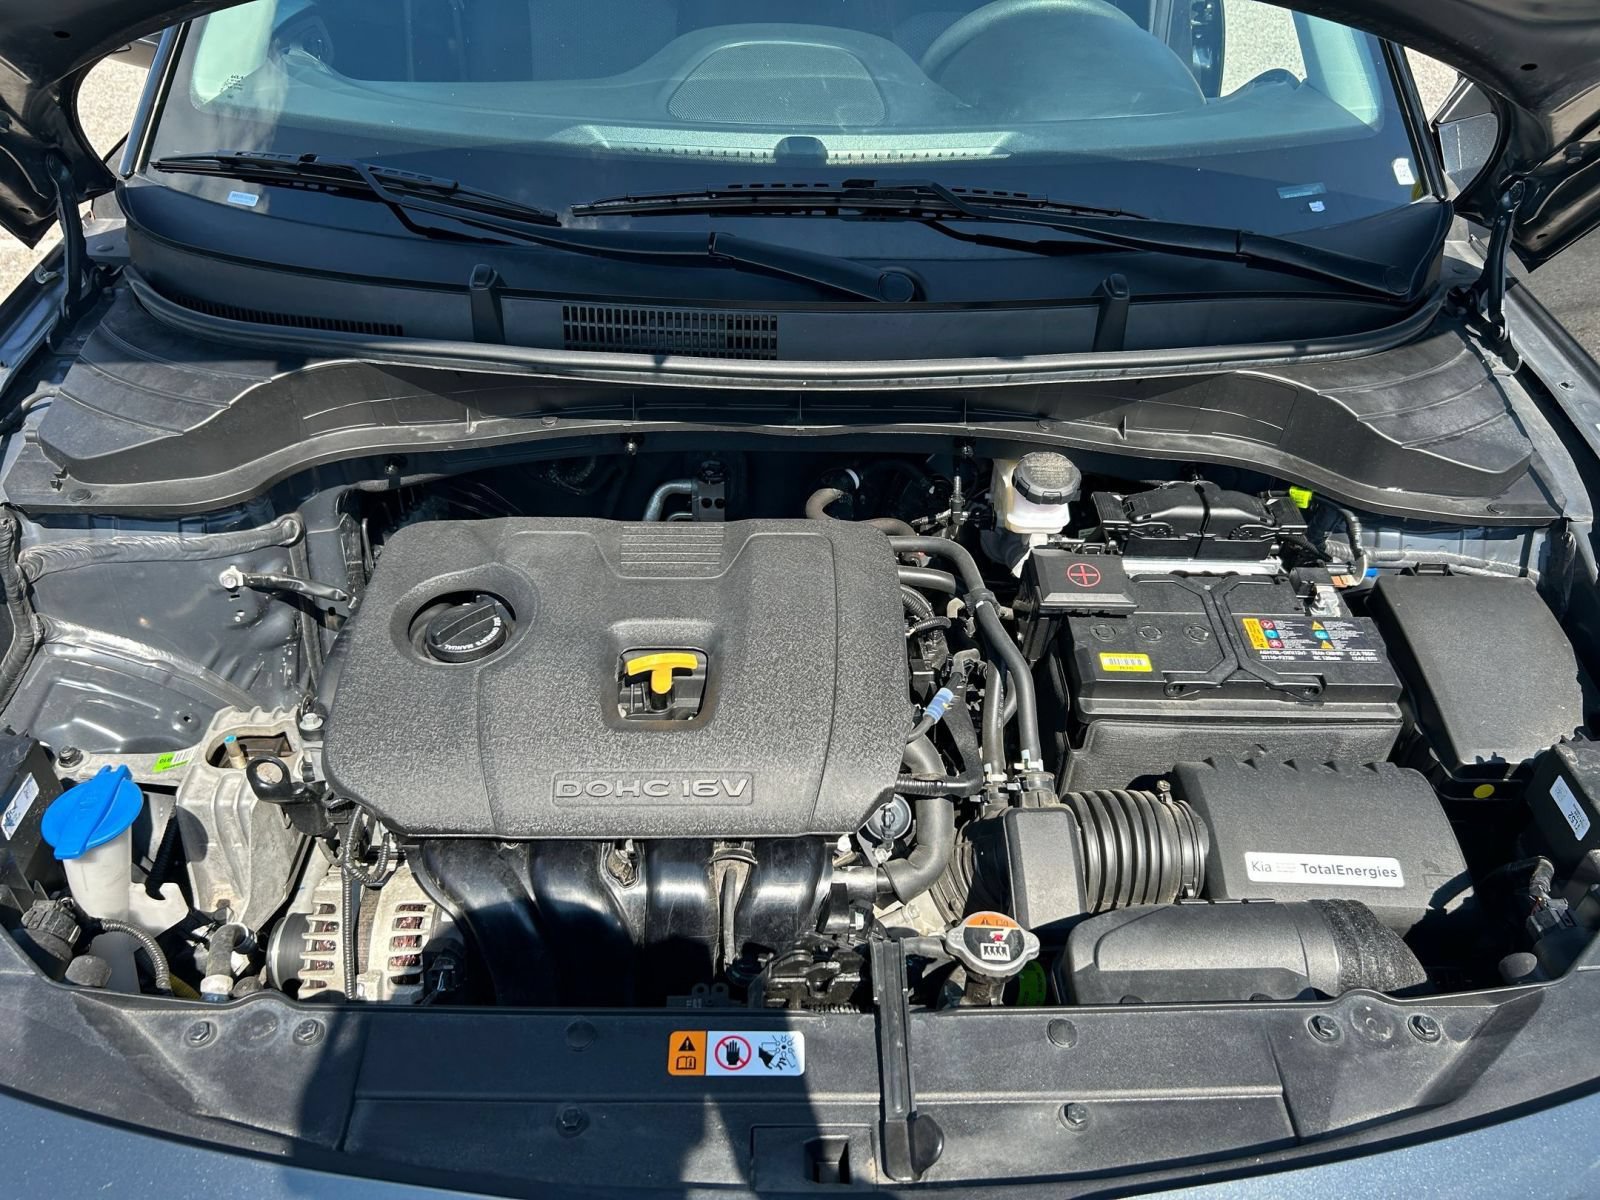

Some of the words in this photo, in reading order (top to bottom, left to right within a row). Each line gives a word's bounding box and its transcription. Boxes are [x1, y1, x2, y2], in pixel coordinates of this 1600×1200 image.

[556, 779, 670, 798] DOHC
[681, 779, 749, 797] 16V
[1251, 860, 1272, 873] Kia
[1300, 862, 1398, 879] TotalEnergies
